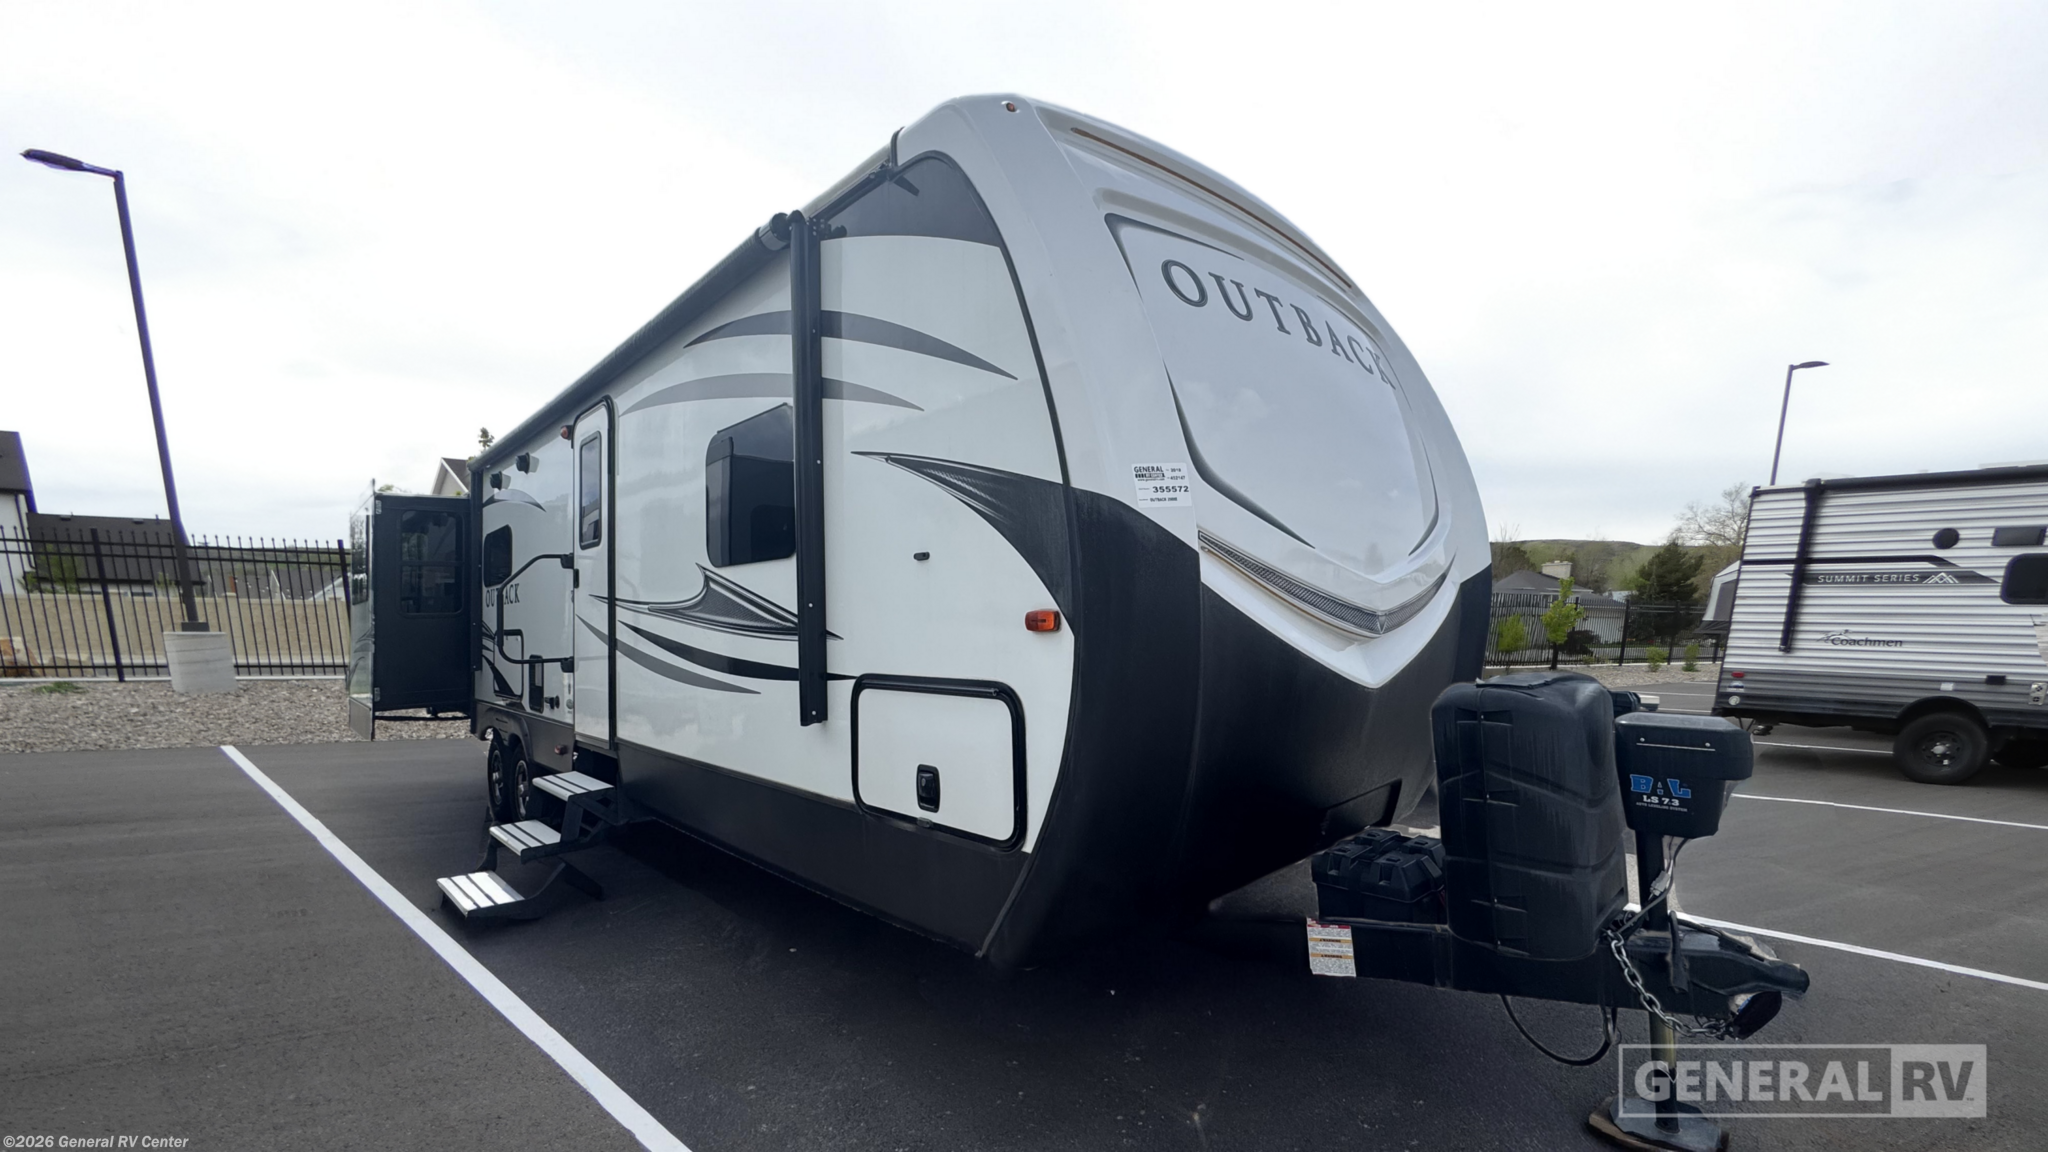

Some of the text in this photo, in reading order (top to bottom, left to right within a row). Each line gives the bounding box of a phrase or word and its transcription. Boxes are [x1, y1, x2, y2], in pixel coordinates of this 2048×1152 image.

[1161, 258, 1396, 390] OUTBACK
[1133, 465, 1164, 473] GENERAL
[1152, 485, 1190, 494] 355572
[1817, 573, 1920, 583] SUMMIT SERIES
[485, 583, 520, 608] OUACK
[1830, 637, 1903, 647] Coachmen
[1642, 794, 1659, 804] LS
